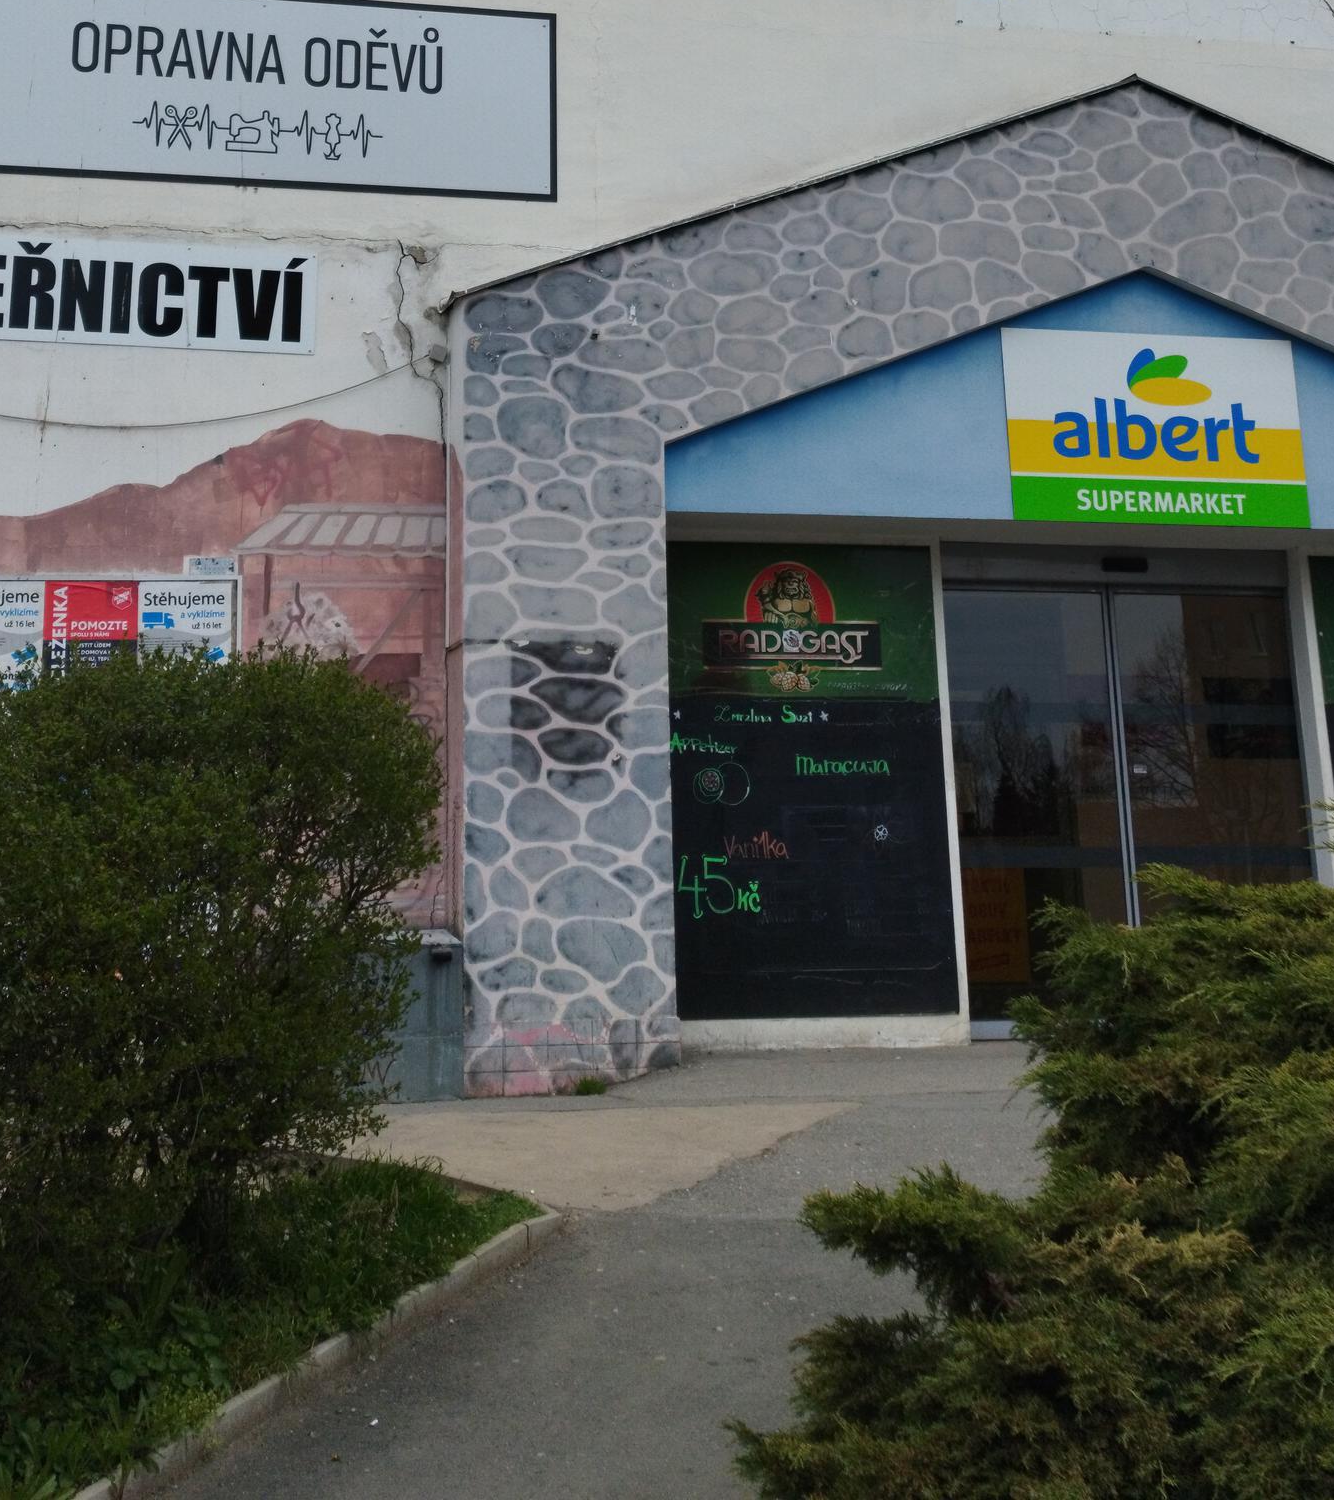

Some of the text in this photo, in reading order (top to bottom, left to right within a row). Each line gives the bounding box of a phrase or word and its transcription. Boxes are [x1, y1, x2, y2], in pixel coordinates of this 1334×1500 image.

[71, 21, 444, 95] OPRAVNA ODĚVŮ
[1053, 396, 1260, 464] albert
[1076, 488, 1247, 515] SUPERMARKET
[144, 592, 225, 609] Stěhujeme
[70, 621, 128, 631] POMOZTE
[212, 621, 222, 629] let
[718, 628, 869, 664] RADGAST
